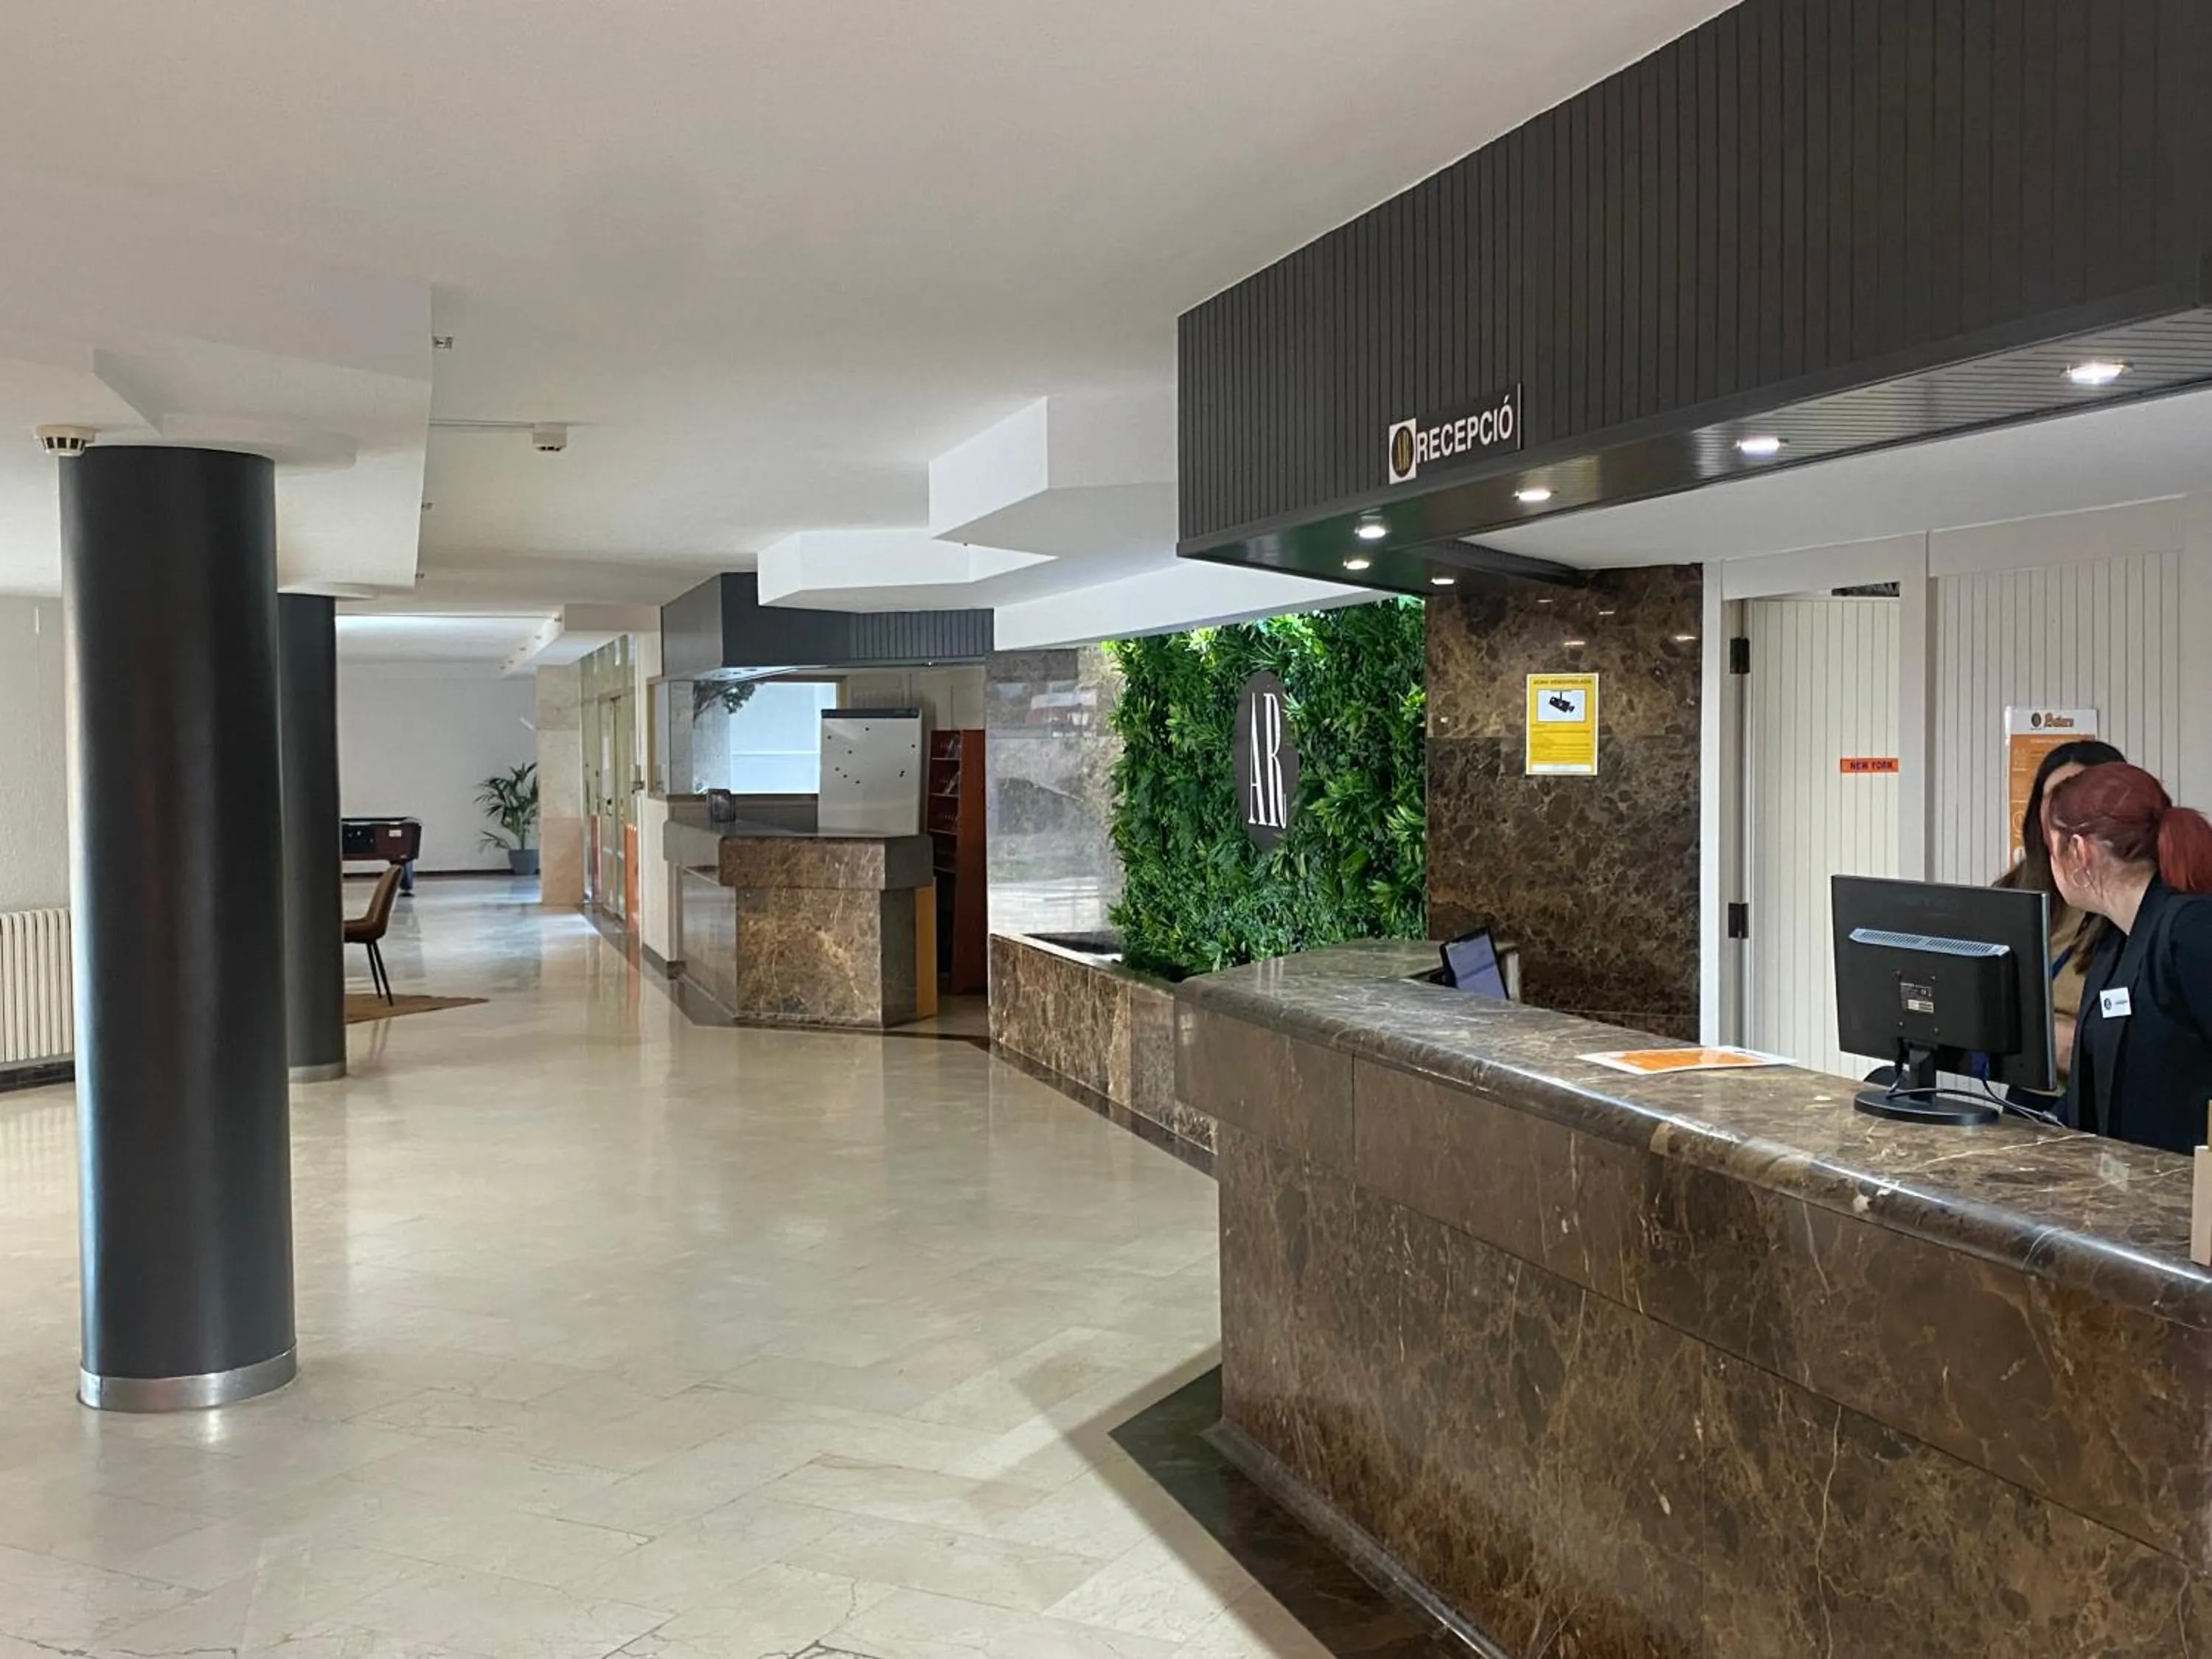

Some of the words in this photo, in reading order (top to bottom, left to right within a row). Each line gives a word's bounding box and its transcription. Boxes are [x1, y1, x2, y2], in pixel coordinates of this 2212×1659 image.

[1416, 394, 1513, 464] RECEPCIÓ
[1248, 692, 1287, 830] AR
[1850, 762, 1868, 770] NEW
[1872, 761, 1893, 770] YORK
